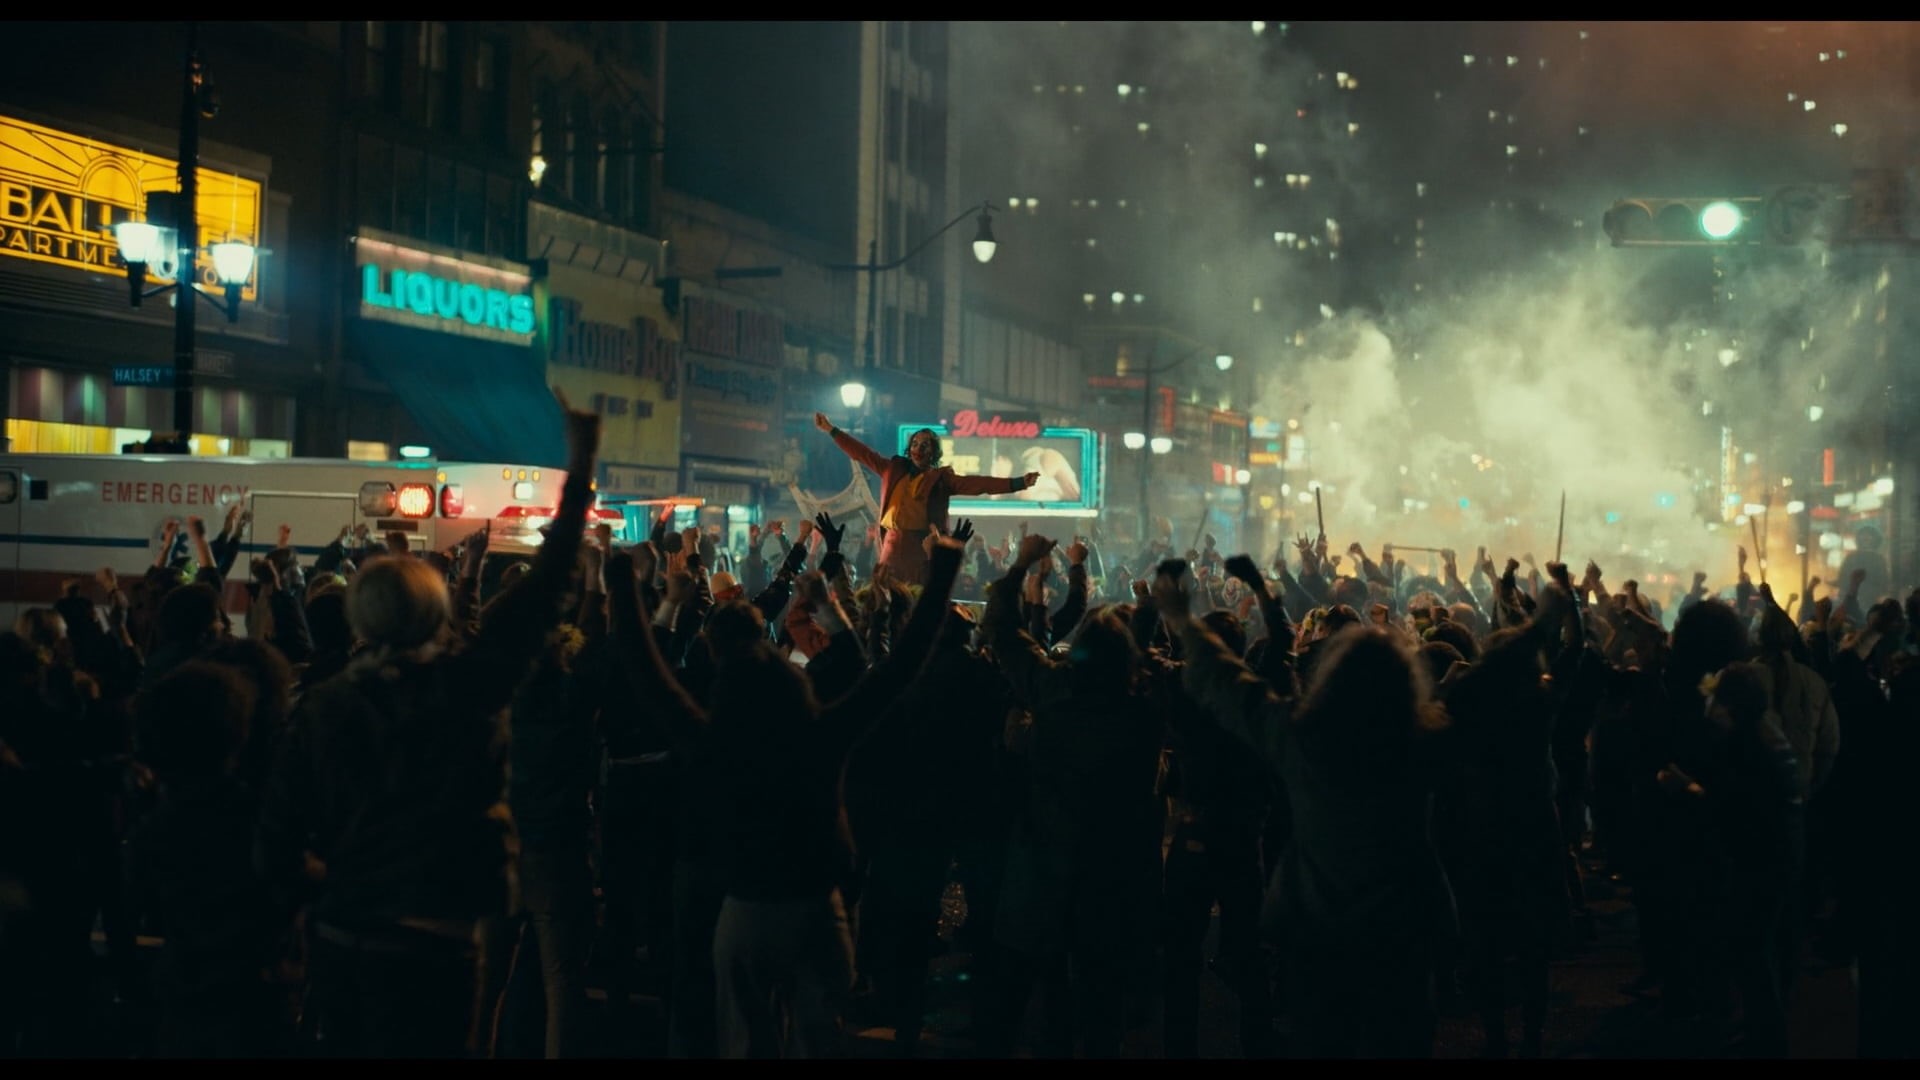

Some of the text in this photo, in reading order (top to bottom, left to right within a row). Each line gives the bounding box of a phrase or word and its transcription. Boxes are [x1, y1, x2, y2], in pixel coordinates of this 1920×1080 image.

[0, 181, 146, 241] BALL
[0, 226, 120, 268] ARTME
[363, 264, 536, 335] LIQUORS
[550, 297, 636, 376] Home
[114, 368, 161, 383] HALSEY
[952, 409, 1040, 438] Deluxe
[102, 481, 249, 506] EMERGENCY
